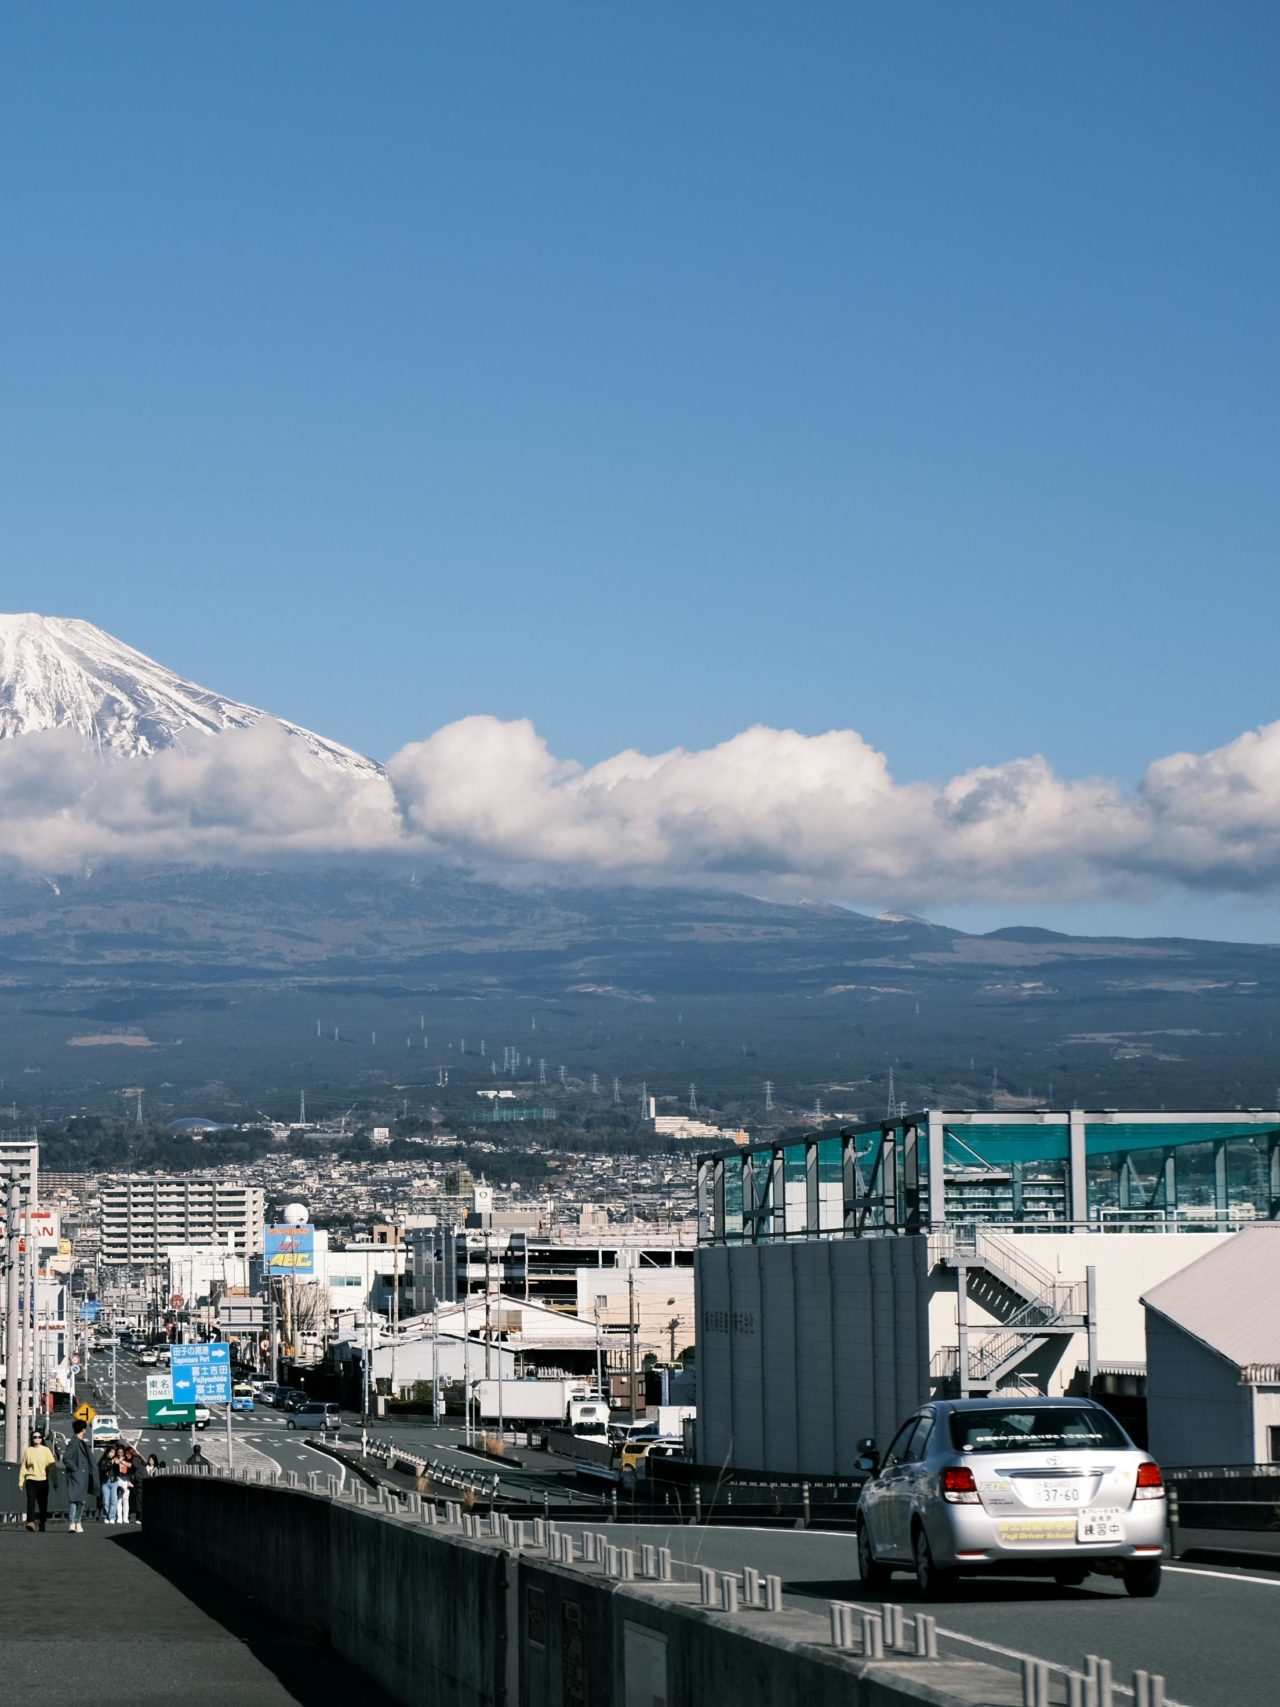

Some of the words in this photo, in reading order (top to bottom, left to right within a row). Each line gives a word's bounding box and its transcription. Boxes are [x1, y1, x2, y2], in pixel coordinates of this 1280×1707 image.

[270, 1253, 313, 1267] ABC
[192, 1365, 228, 1376] 富士吉田
[149, 1379, 170, 1389] 東名
[192, 1375, 228, 1384] Fujiyoshida
[195, 1384, 225, 1394] 富士宮
[195, 1394, 227, 1402] Fujinomiya
[1044, 1489, 1079, 1502] 37-60
[1084, 1523, 1120, 1536] 練習中
[1001, 1533, 1019, 1541] Fuji
[1019, 1532, 1047, 1540] Driver
